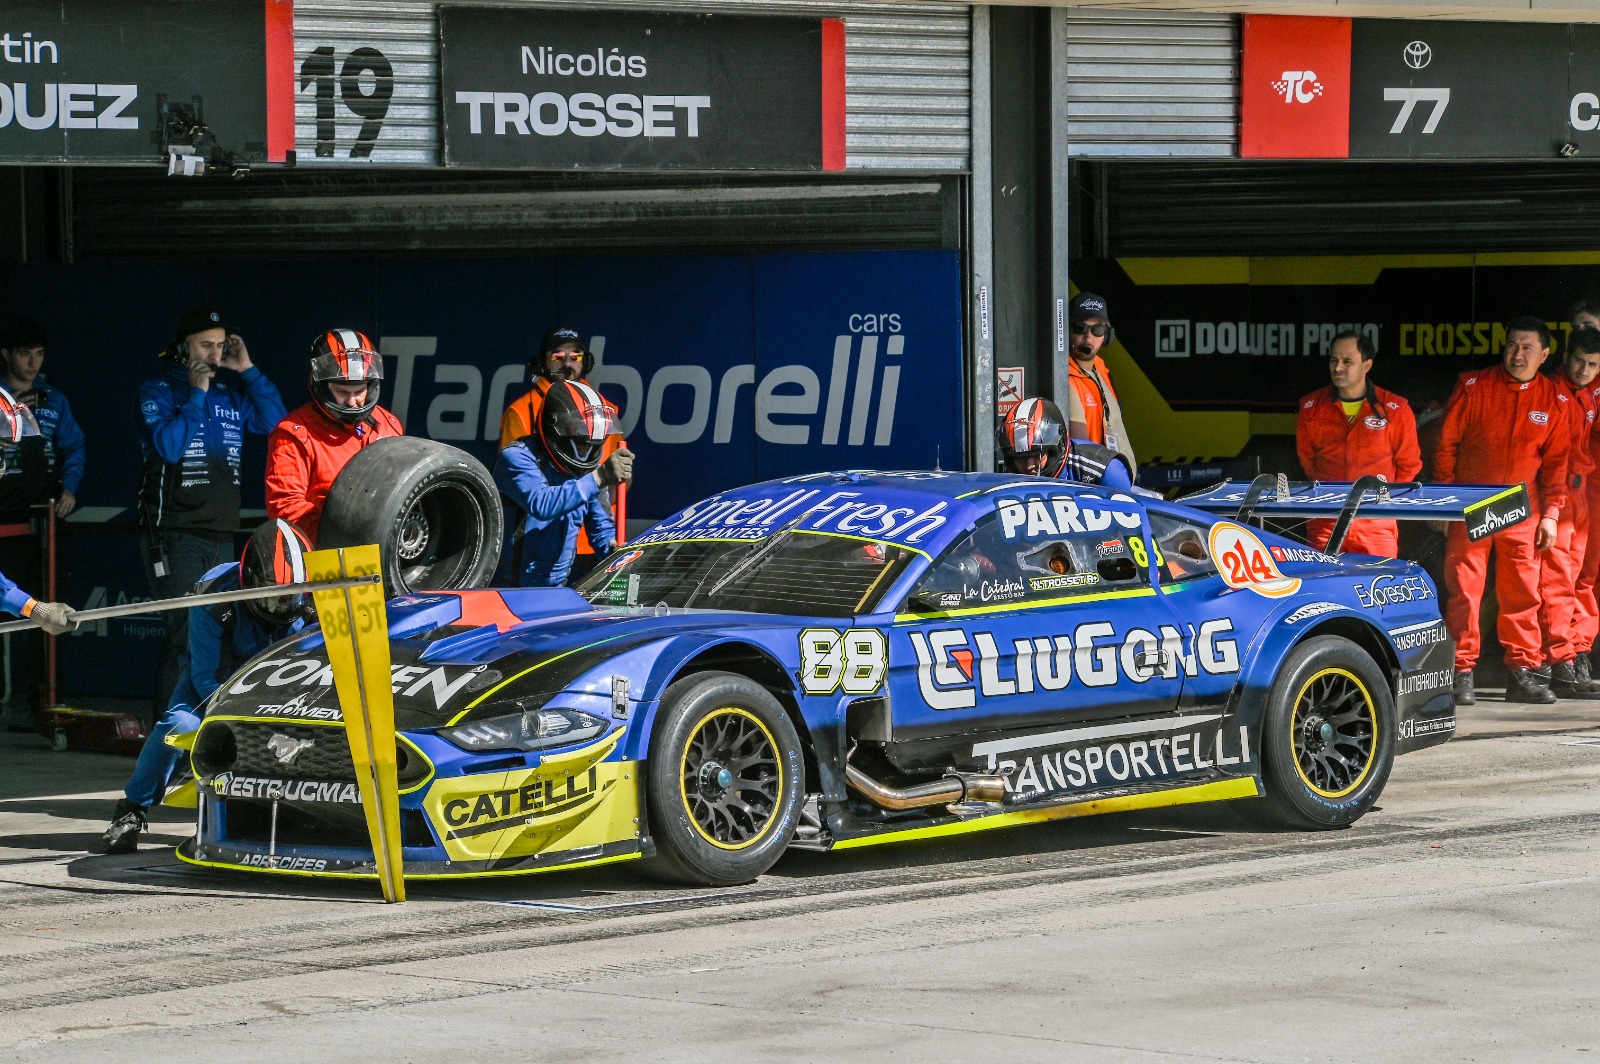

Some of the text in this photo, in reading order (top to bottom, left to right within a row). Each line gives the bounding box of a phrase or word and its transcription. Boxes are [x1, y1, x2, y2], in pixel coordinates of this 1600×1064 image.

[521, 45, 648, 78] Nicolás
[301, 47, 393, 158] 19
[1280, 70, 1318, 104] TC
[455, 91, 711, 139] TROSSET
[1383, 87, 1451, 135] 77
[1569, 92, 1600, 132] C
[848, 313, 902, 333] cars
[1195, 322, 1296, 356] DOWEN
[653, 488, 950, 543] Smell Fresh
[1470, 506, 1527, 540] TROMEN
[963, 583, 979, 600] La
[798, 627, 888, 696] 88
[254, 698, 345, 720] TROMEN
[1398, 718, 1415, 740] SGI
[971, 714, 1251, 794] TRANSPORTELLI
[231, 776, 362, 804] ESTRUCMA
[444, 765, 597, 826] CATELLI
